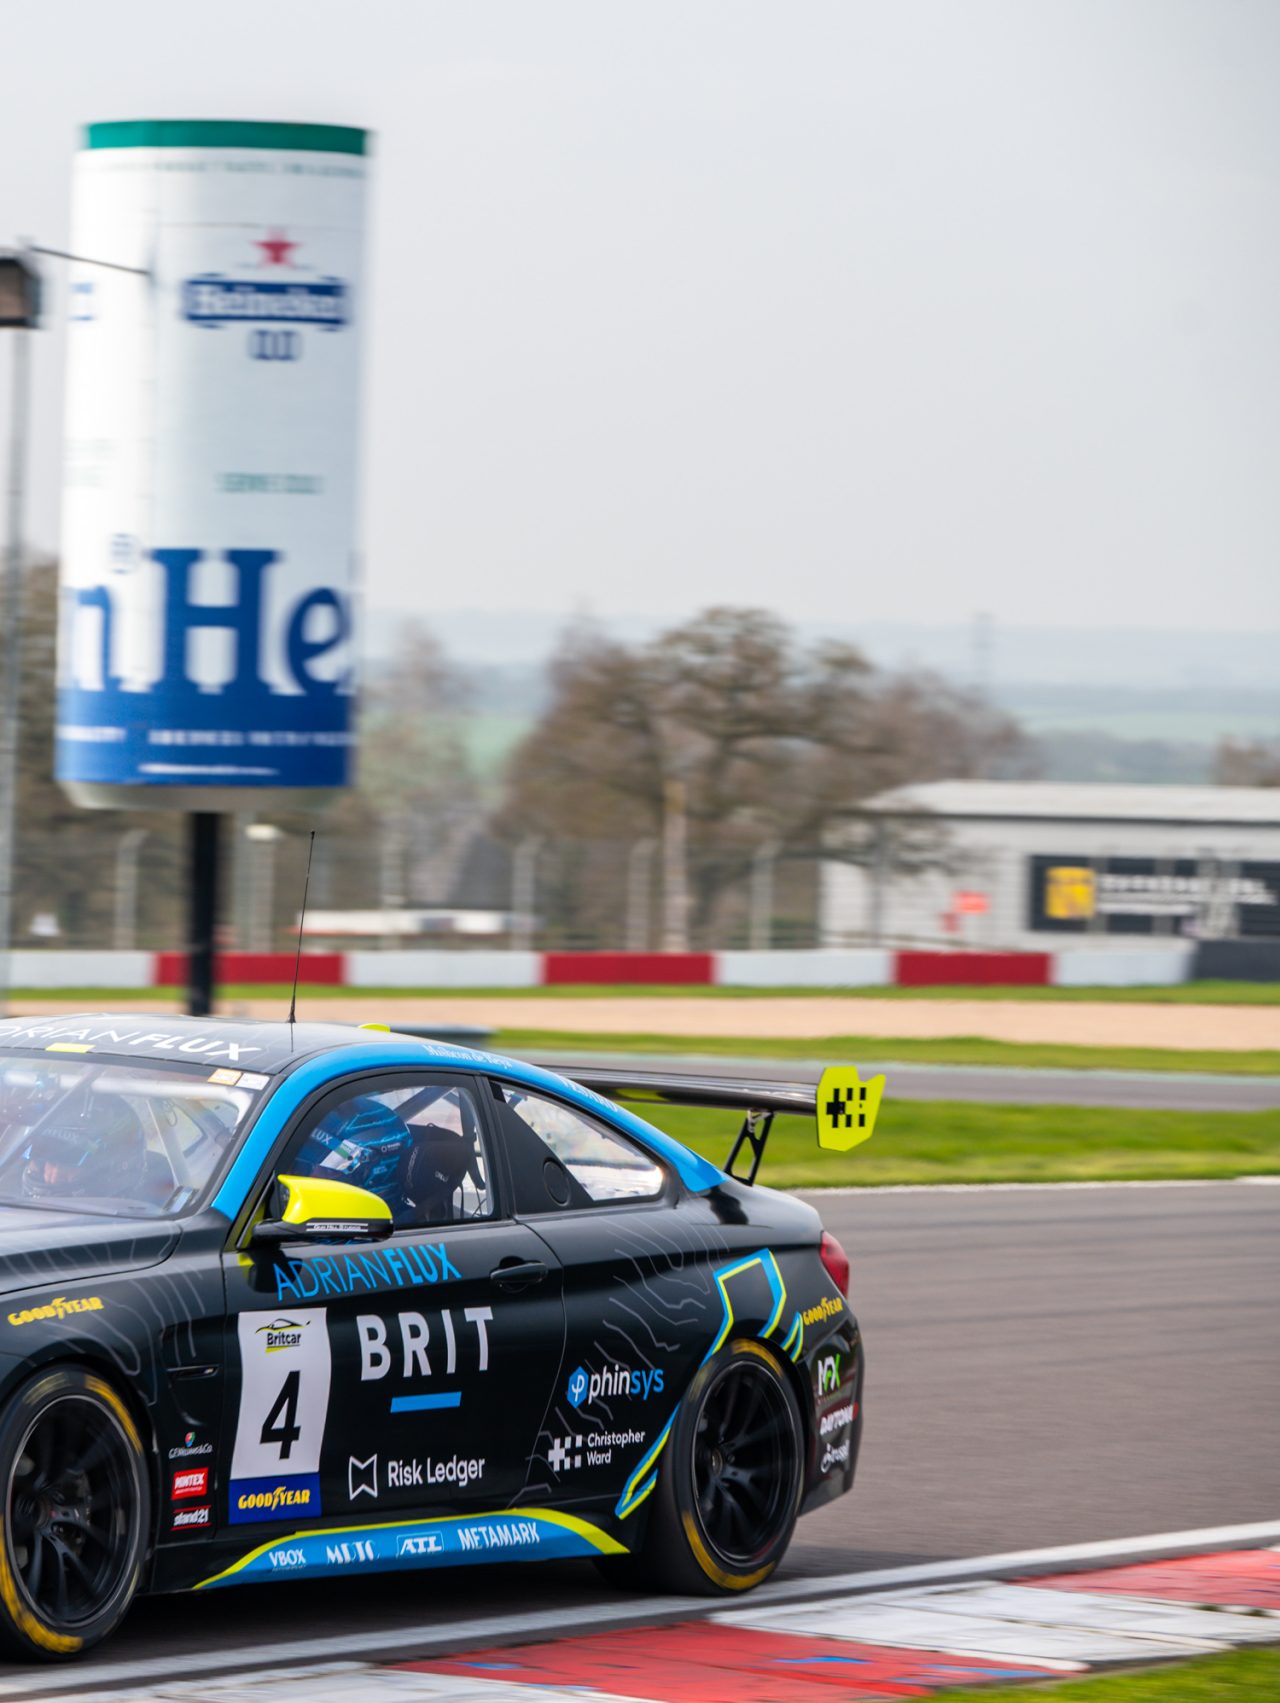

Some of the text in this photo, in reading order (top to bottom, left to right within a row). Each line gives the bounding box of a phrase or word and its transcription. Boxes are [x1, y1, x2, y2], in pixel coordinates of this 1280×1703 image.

[273, 1242, 462, 1301] ADRIANFLUX
[7, 1297, 104, 1326] GOODYEAR
[803, 1296, 843, 1325] GOODYEAR
[266, 1332, 301, 1347] Britcar
[356, 1306, 493, 1381] BRIT
[588, 1364, 665, 1405] phinsys
[260, 1370, 301, 1460] 4
[587, 1429, 646, 1448] Christopher
[388, 1455, 486, 1488] Risk Ledger
[587, 1449, 612, 1466] Ward
[237, 1486, 310, 1511] GOODYEAR
[269, 1549, 306, 1567] VBOX
[457, 1522, 540, 1551] METAMARK
